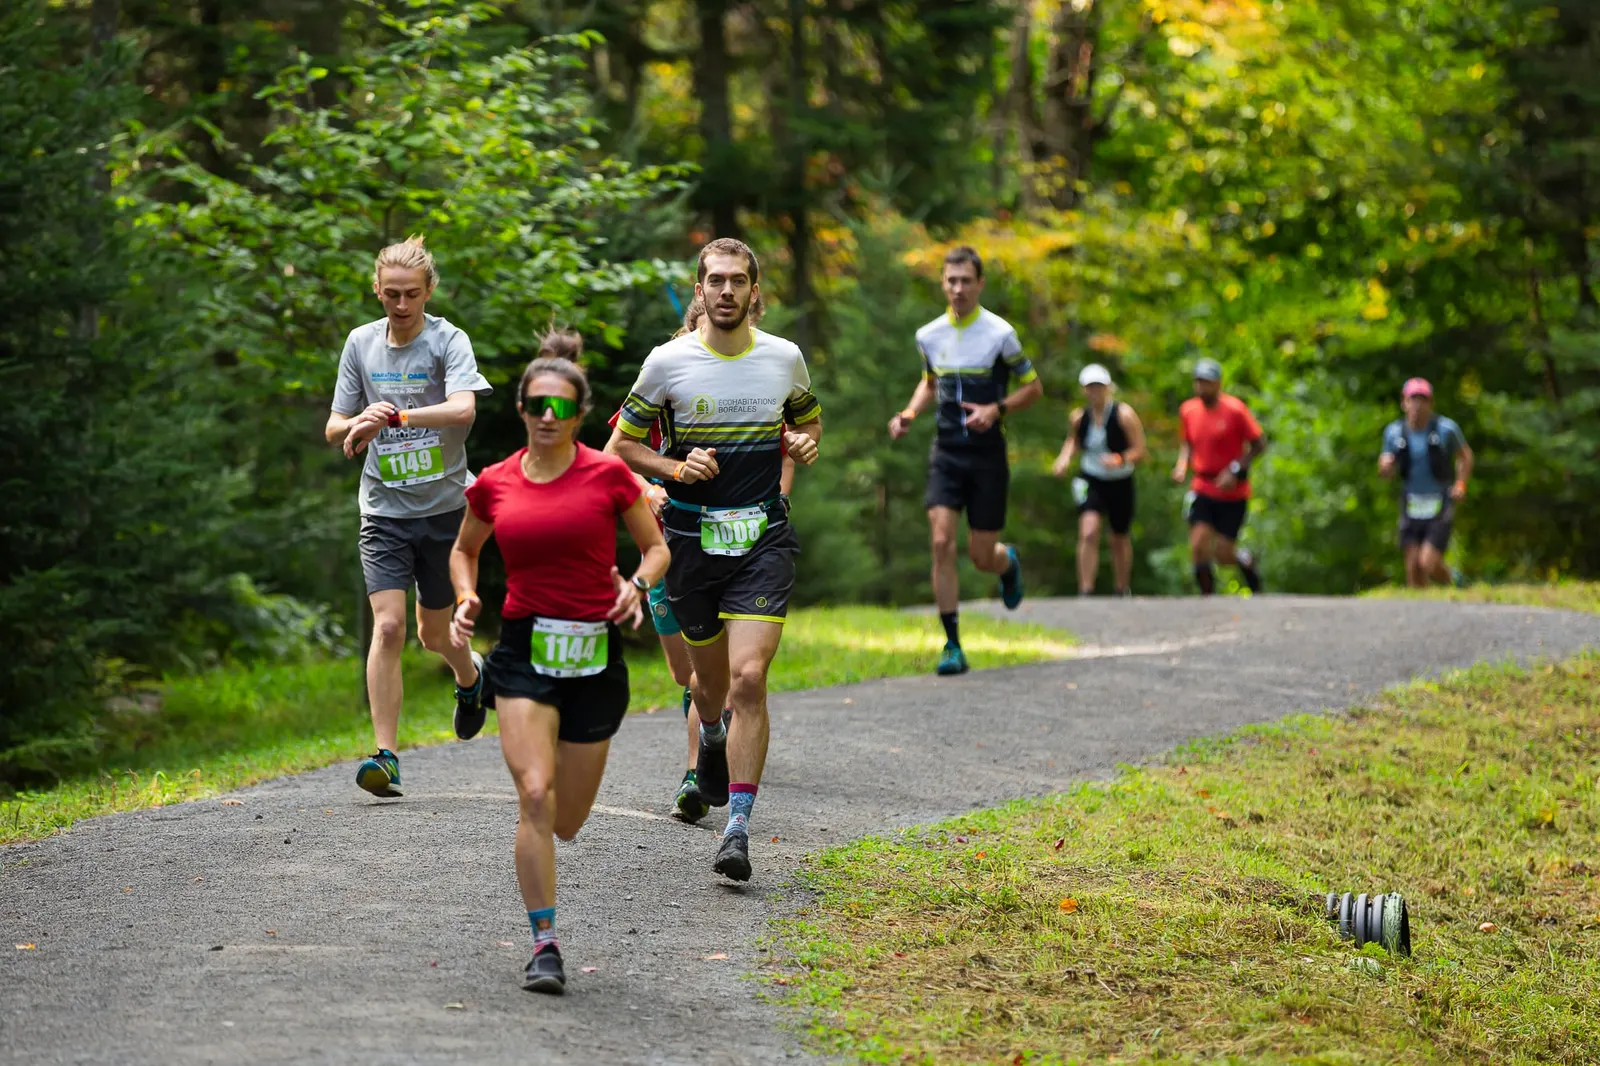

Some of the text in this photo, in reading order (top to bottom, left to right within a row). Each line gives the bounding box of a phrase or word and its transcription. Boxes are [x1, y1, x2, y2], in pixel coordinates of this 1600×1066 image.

[388, 449, 432, 475] 1149
[709, 519, 760, 544] 1008
[544, 634, 597, 663] 1144
